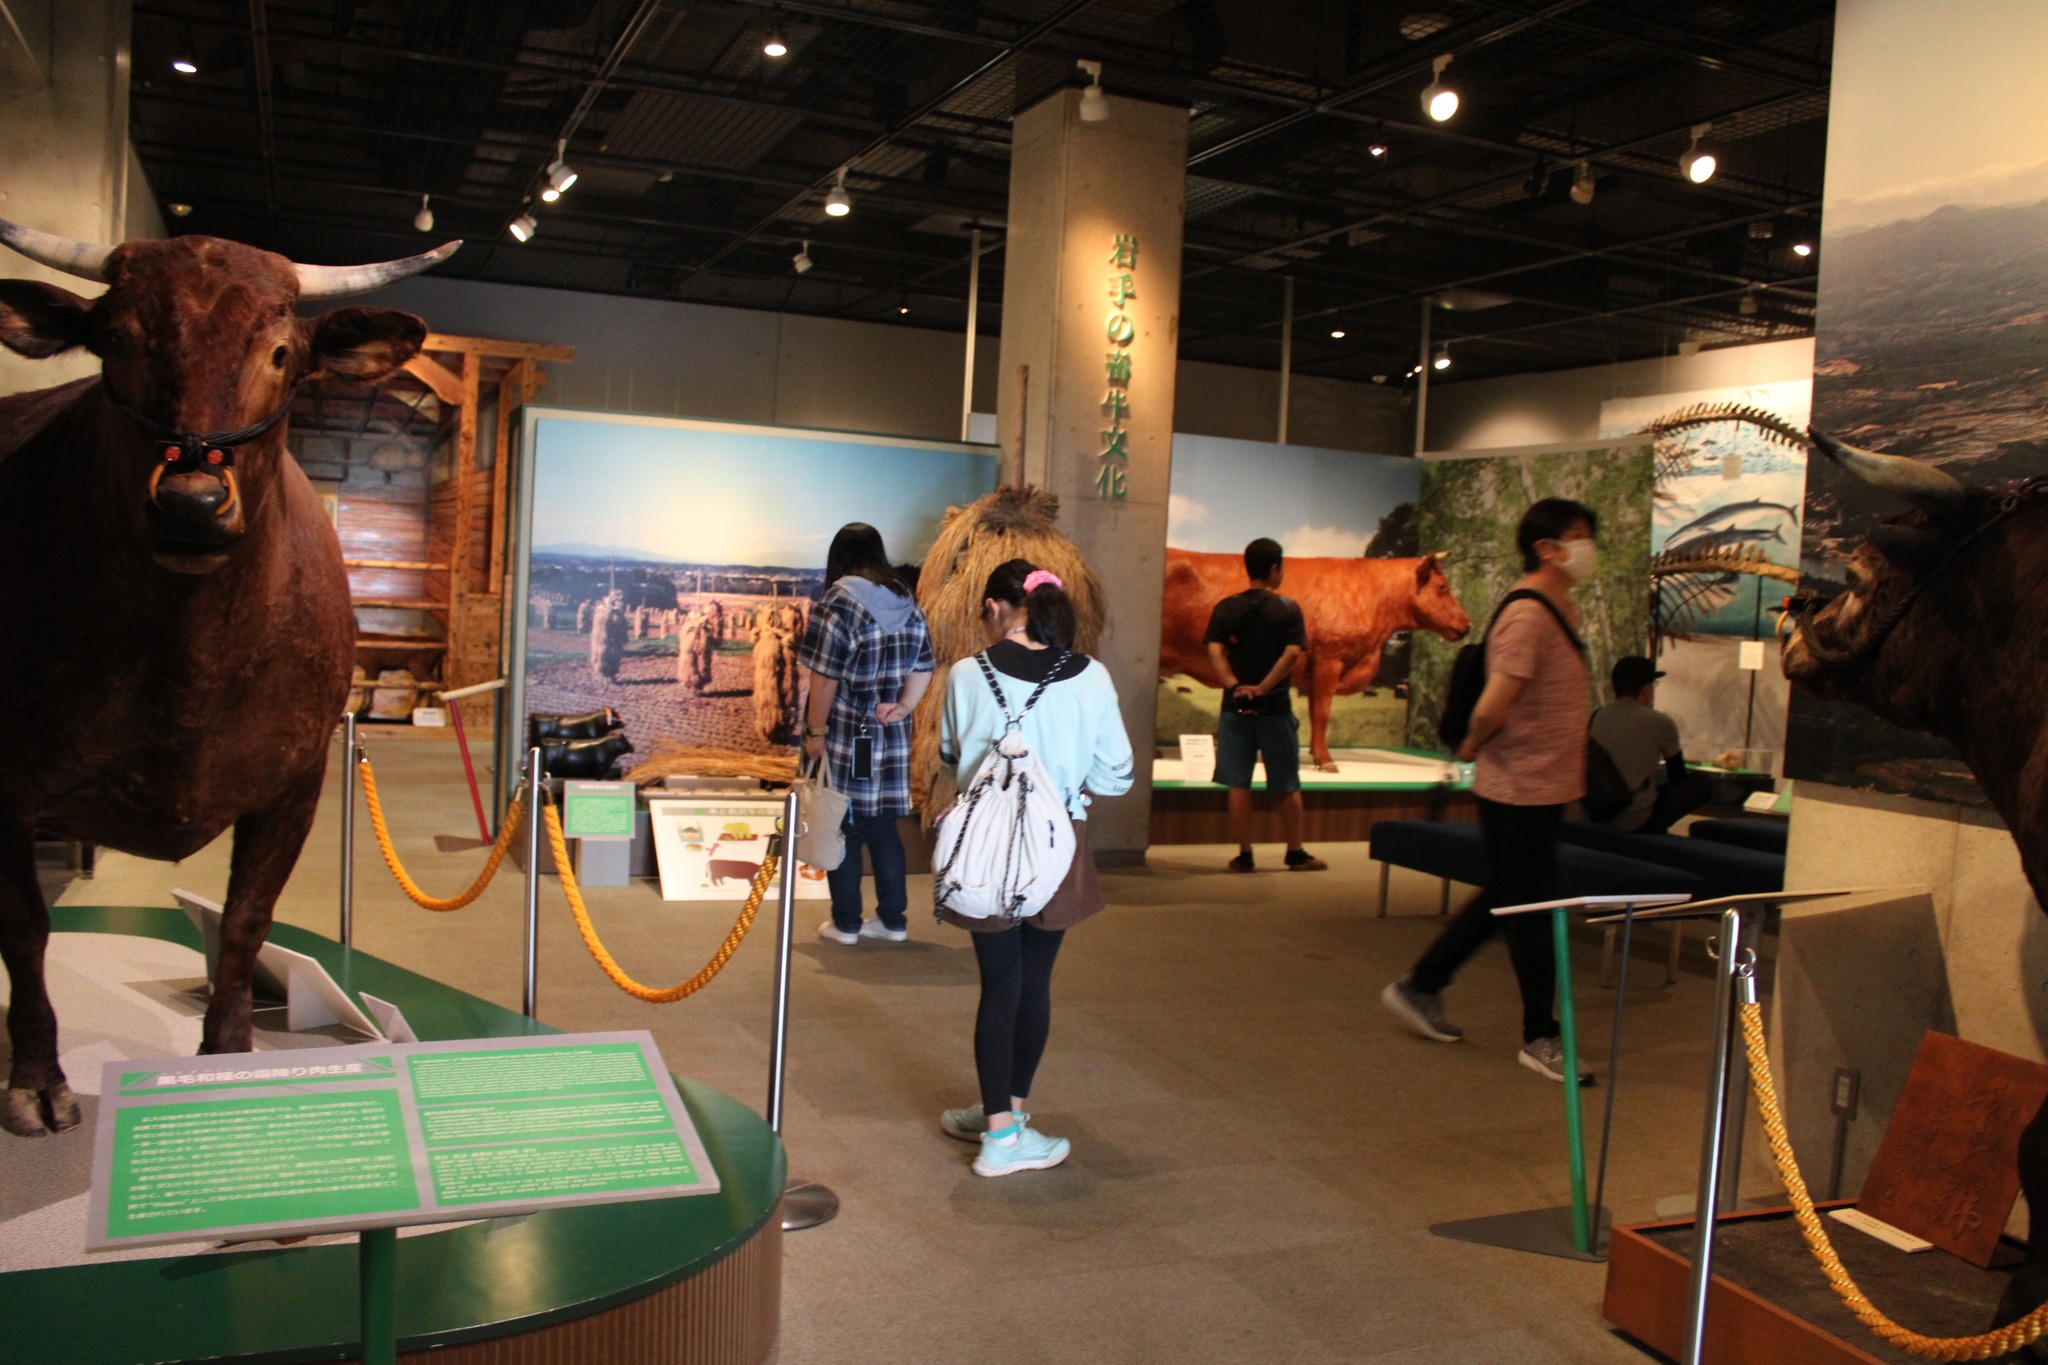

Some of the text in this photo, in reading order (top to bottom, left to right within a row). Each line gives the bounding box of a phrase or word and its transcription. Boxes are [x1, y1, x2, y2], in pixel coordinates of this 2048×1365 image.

[1096, 233, 1139, 497] 岩手の畜牛文化
